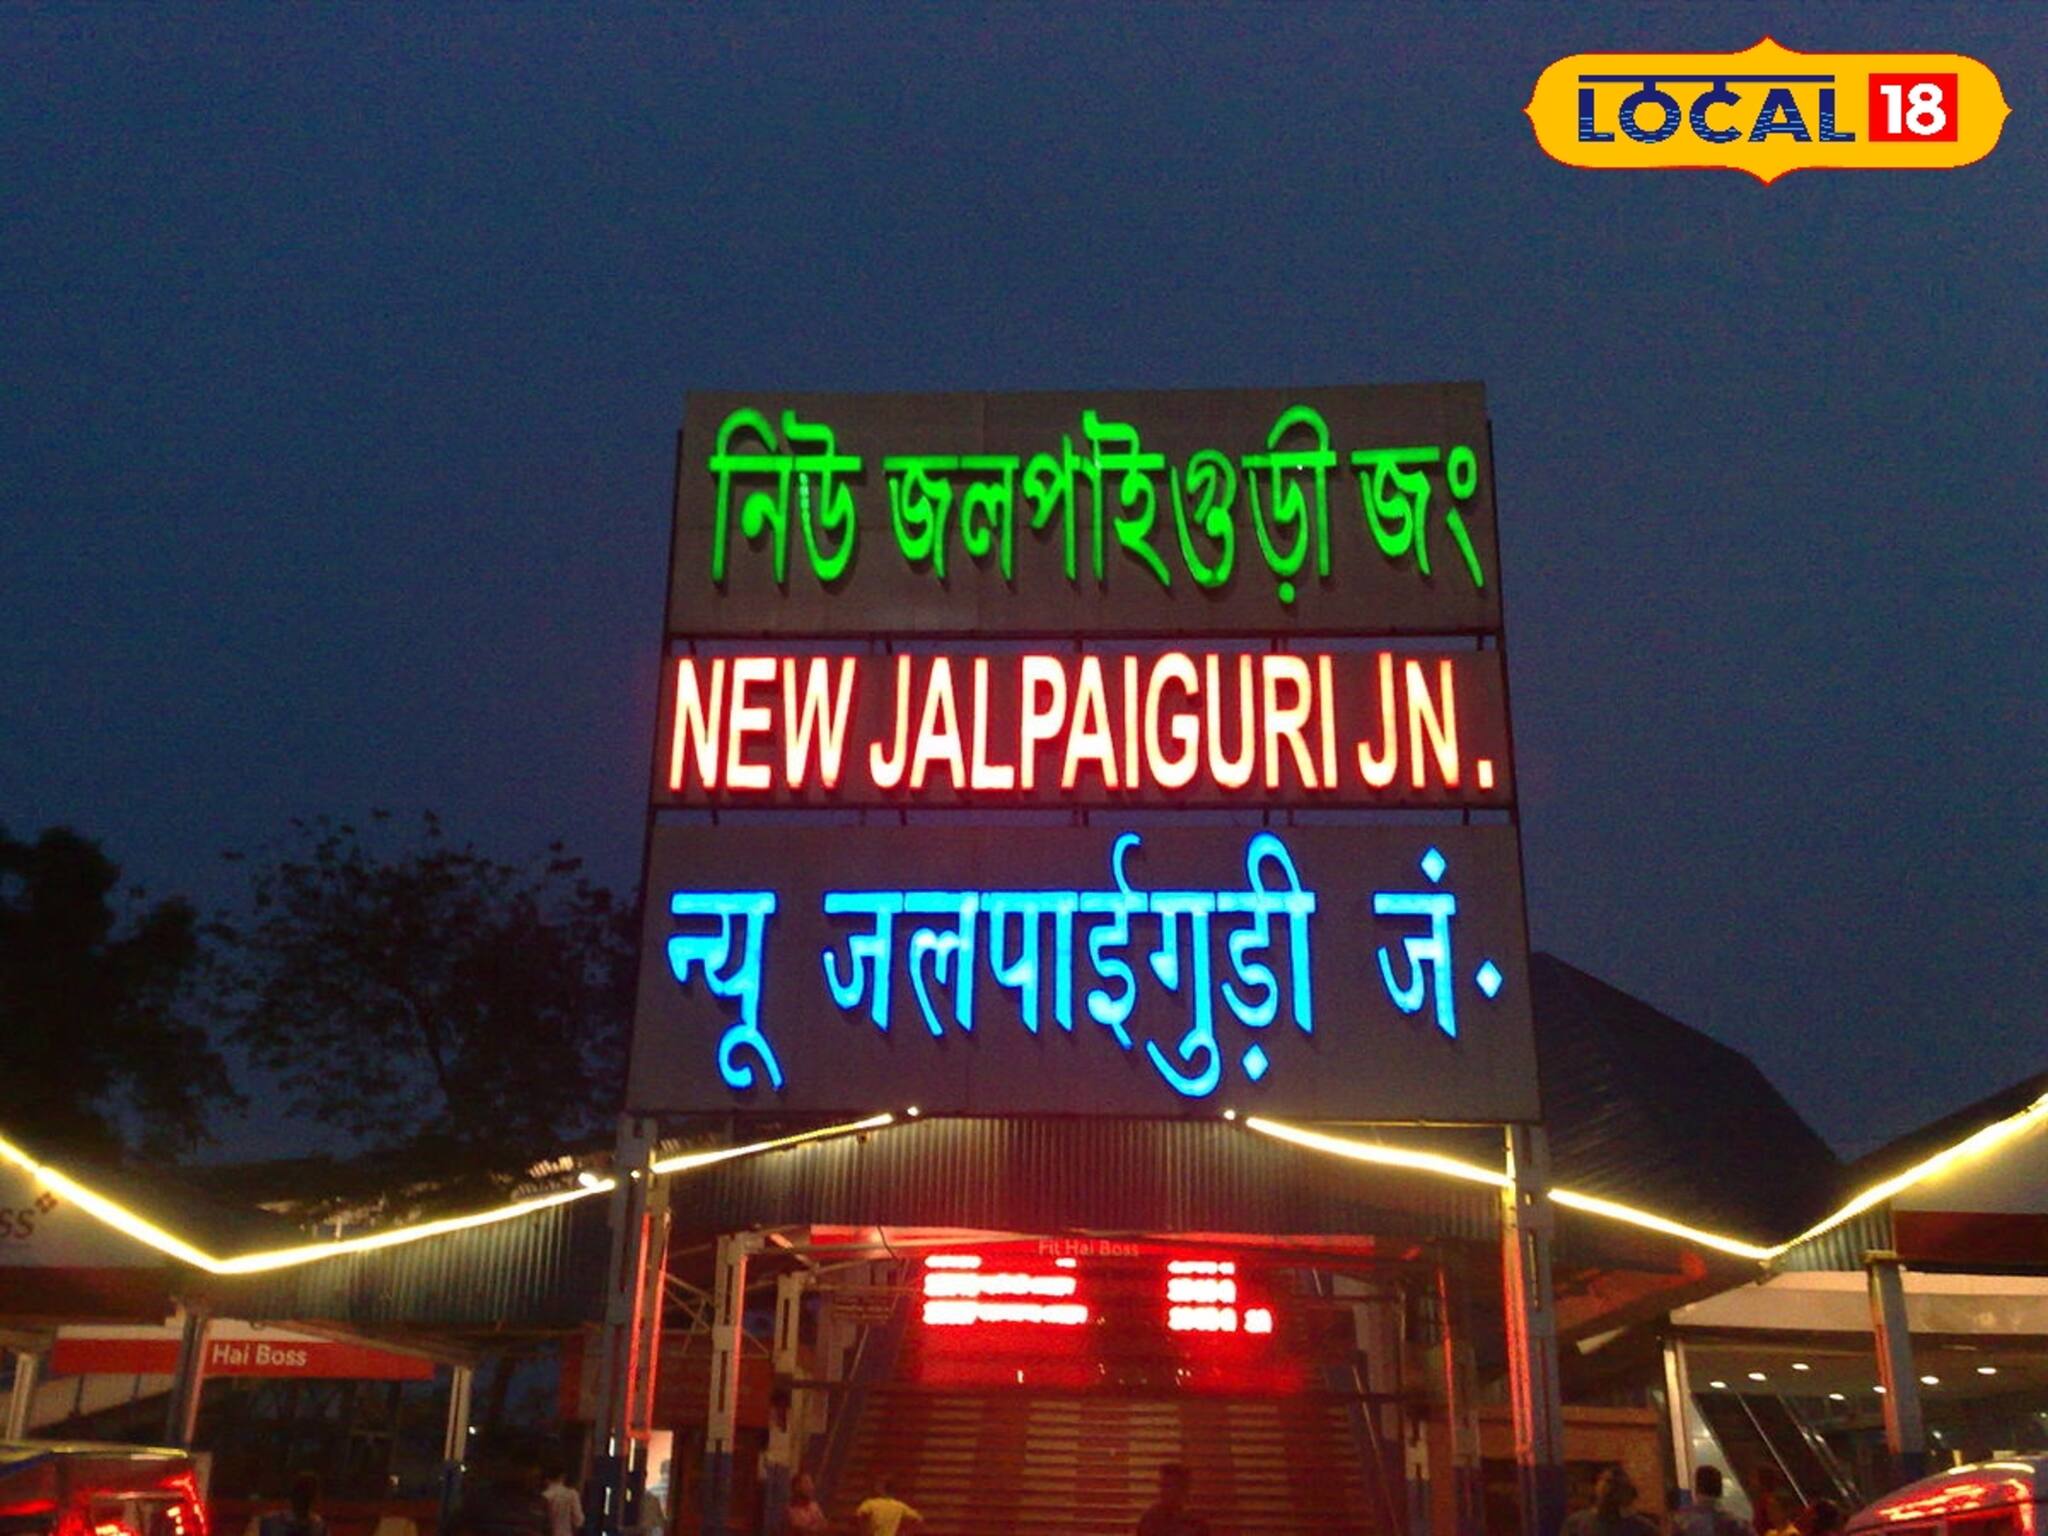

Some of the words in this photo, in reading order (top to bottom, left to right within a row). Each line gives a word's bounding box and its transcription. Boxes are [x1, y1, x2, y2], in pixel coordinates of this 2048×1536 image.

[708, 408, 862, 583] নিউ
[1350, 445, 1483, 587] জং
[669, 655, 856, 789] NEW
[869, 652, 1338, 790] JALPAIGURI
[667, 890, 783, 1089] न्यू
[823, 831, 1317, 1097] जलपाईगुड़ी
[1038, 1239, 1061, 1256] Fit
[1099, 1239, 1139, 1256] Boss
[212, 1342, 250, 1366] Hai
[255, 1342, 308, 1367] Boss
